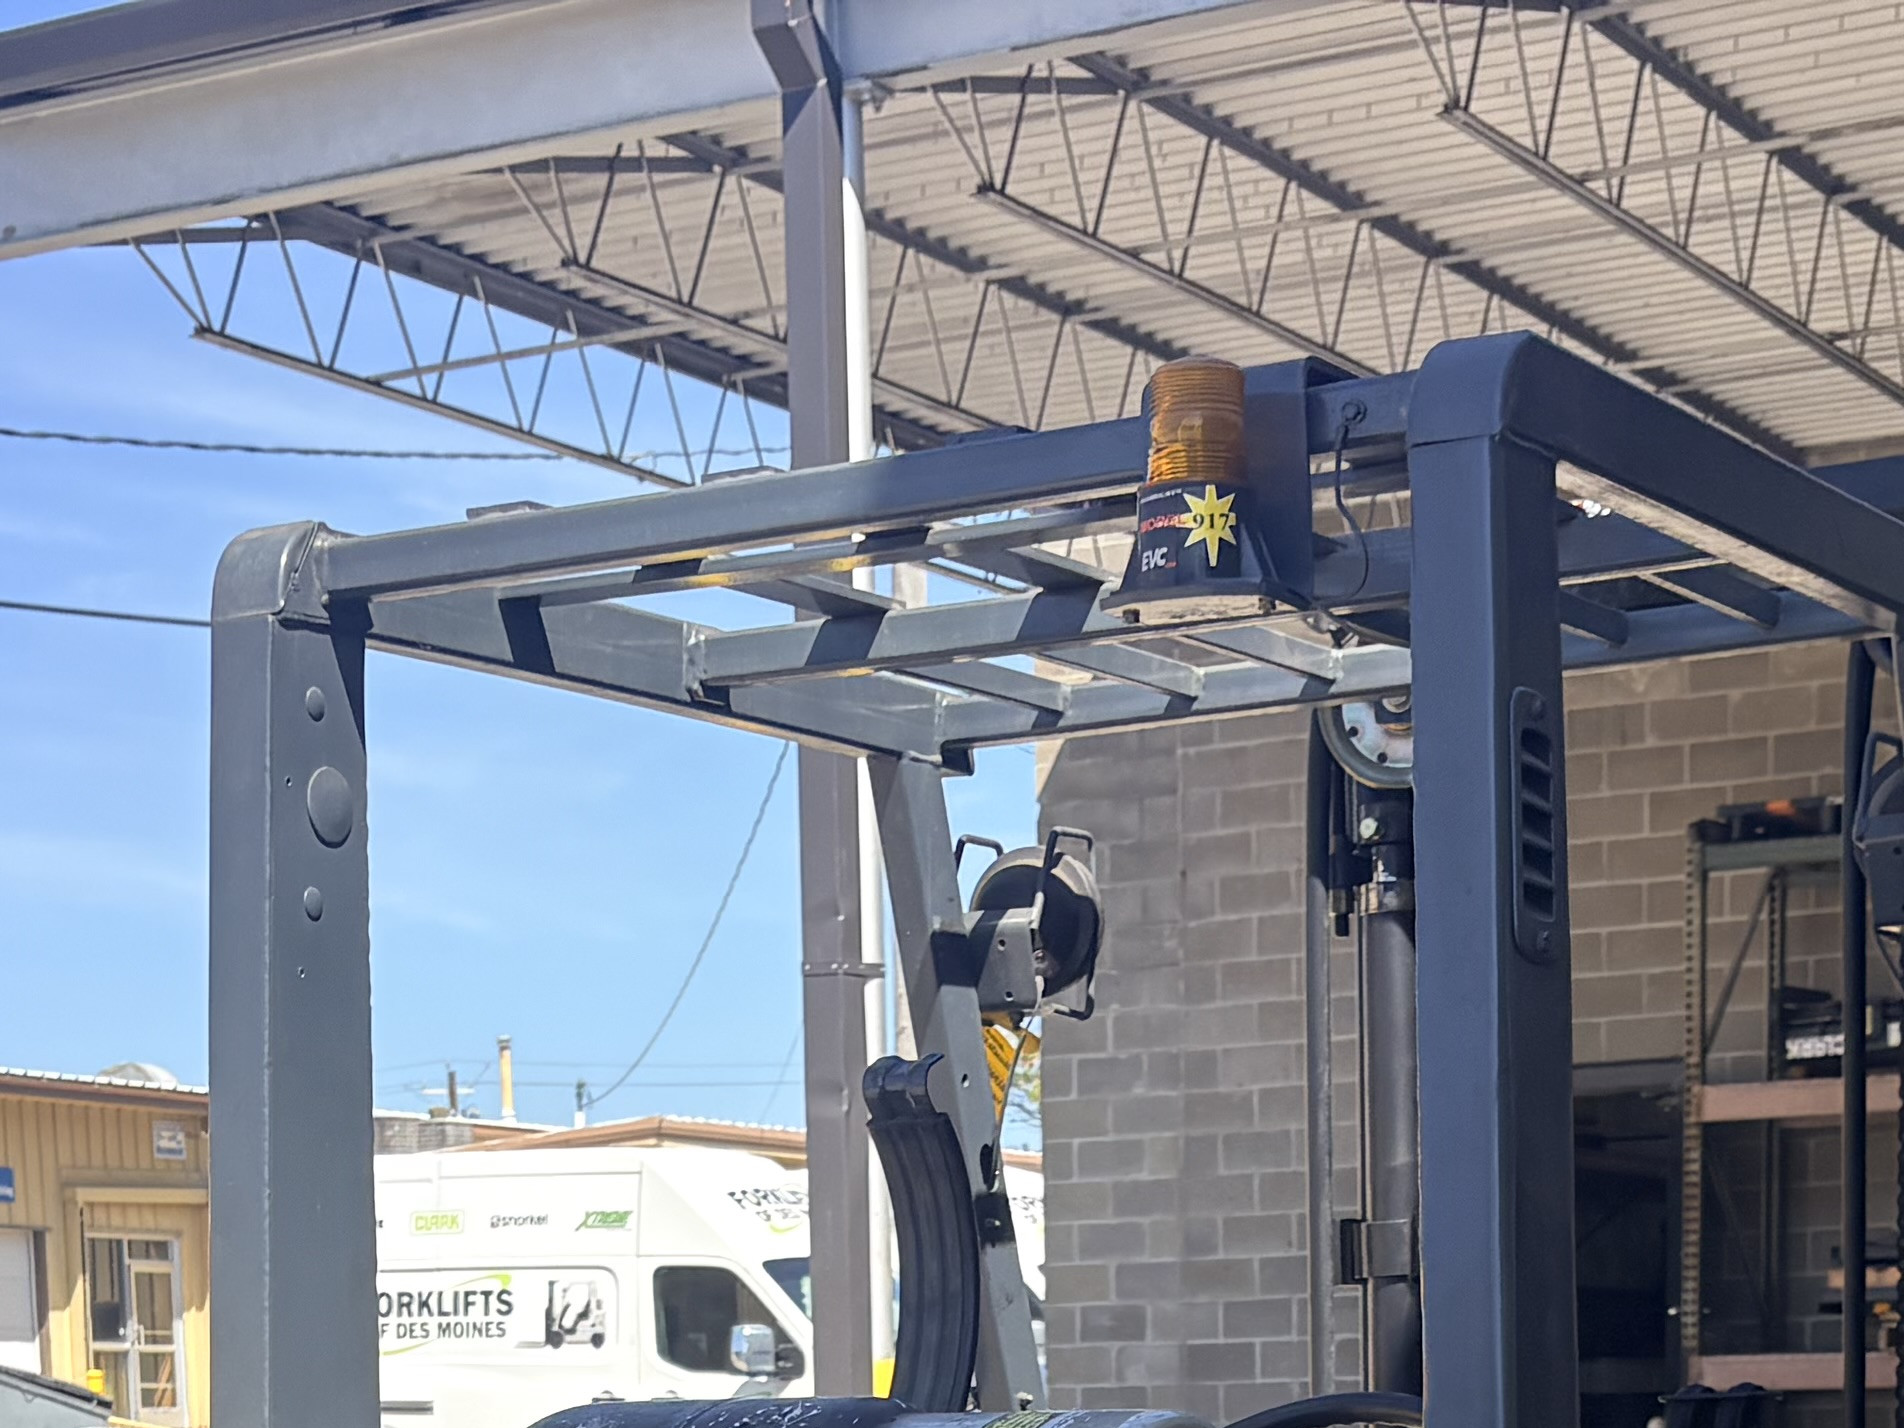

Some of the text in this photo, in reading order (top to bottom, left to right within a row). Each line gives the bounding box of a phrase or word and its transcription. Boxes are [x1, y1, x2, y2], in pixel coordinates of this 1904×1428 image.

[1192, 513, 1230, 531] 917
[377, 1288, 514, 1318] ORKLIFTS
[396, 1322, 430, 1339] DES
[437, 1321, 506, 1338] MOINES
